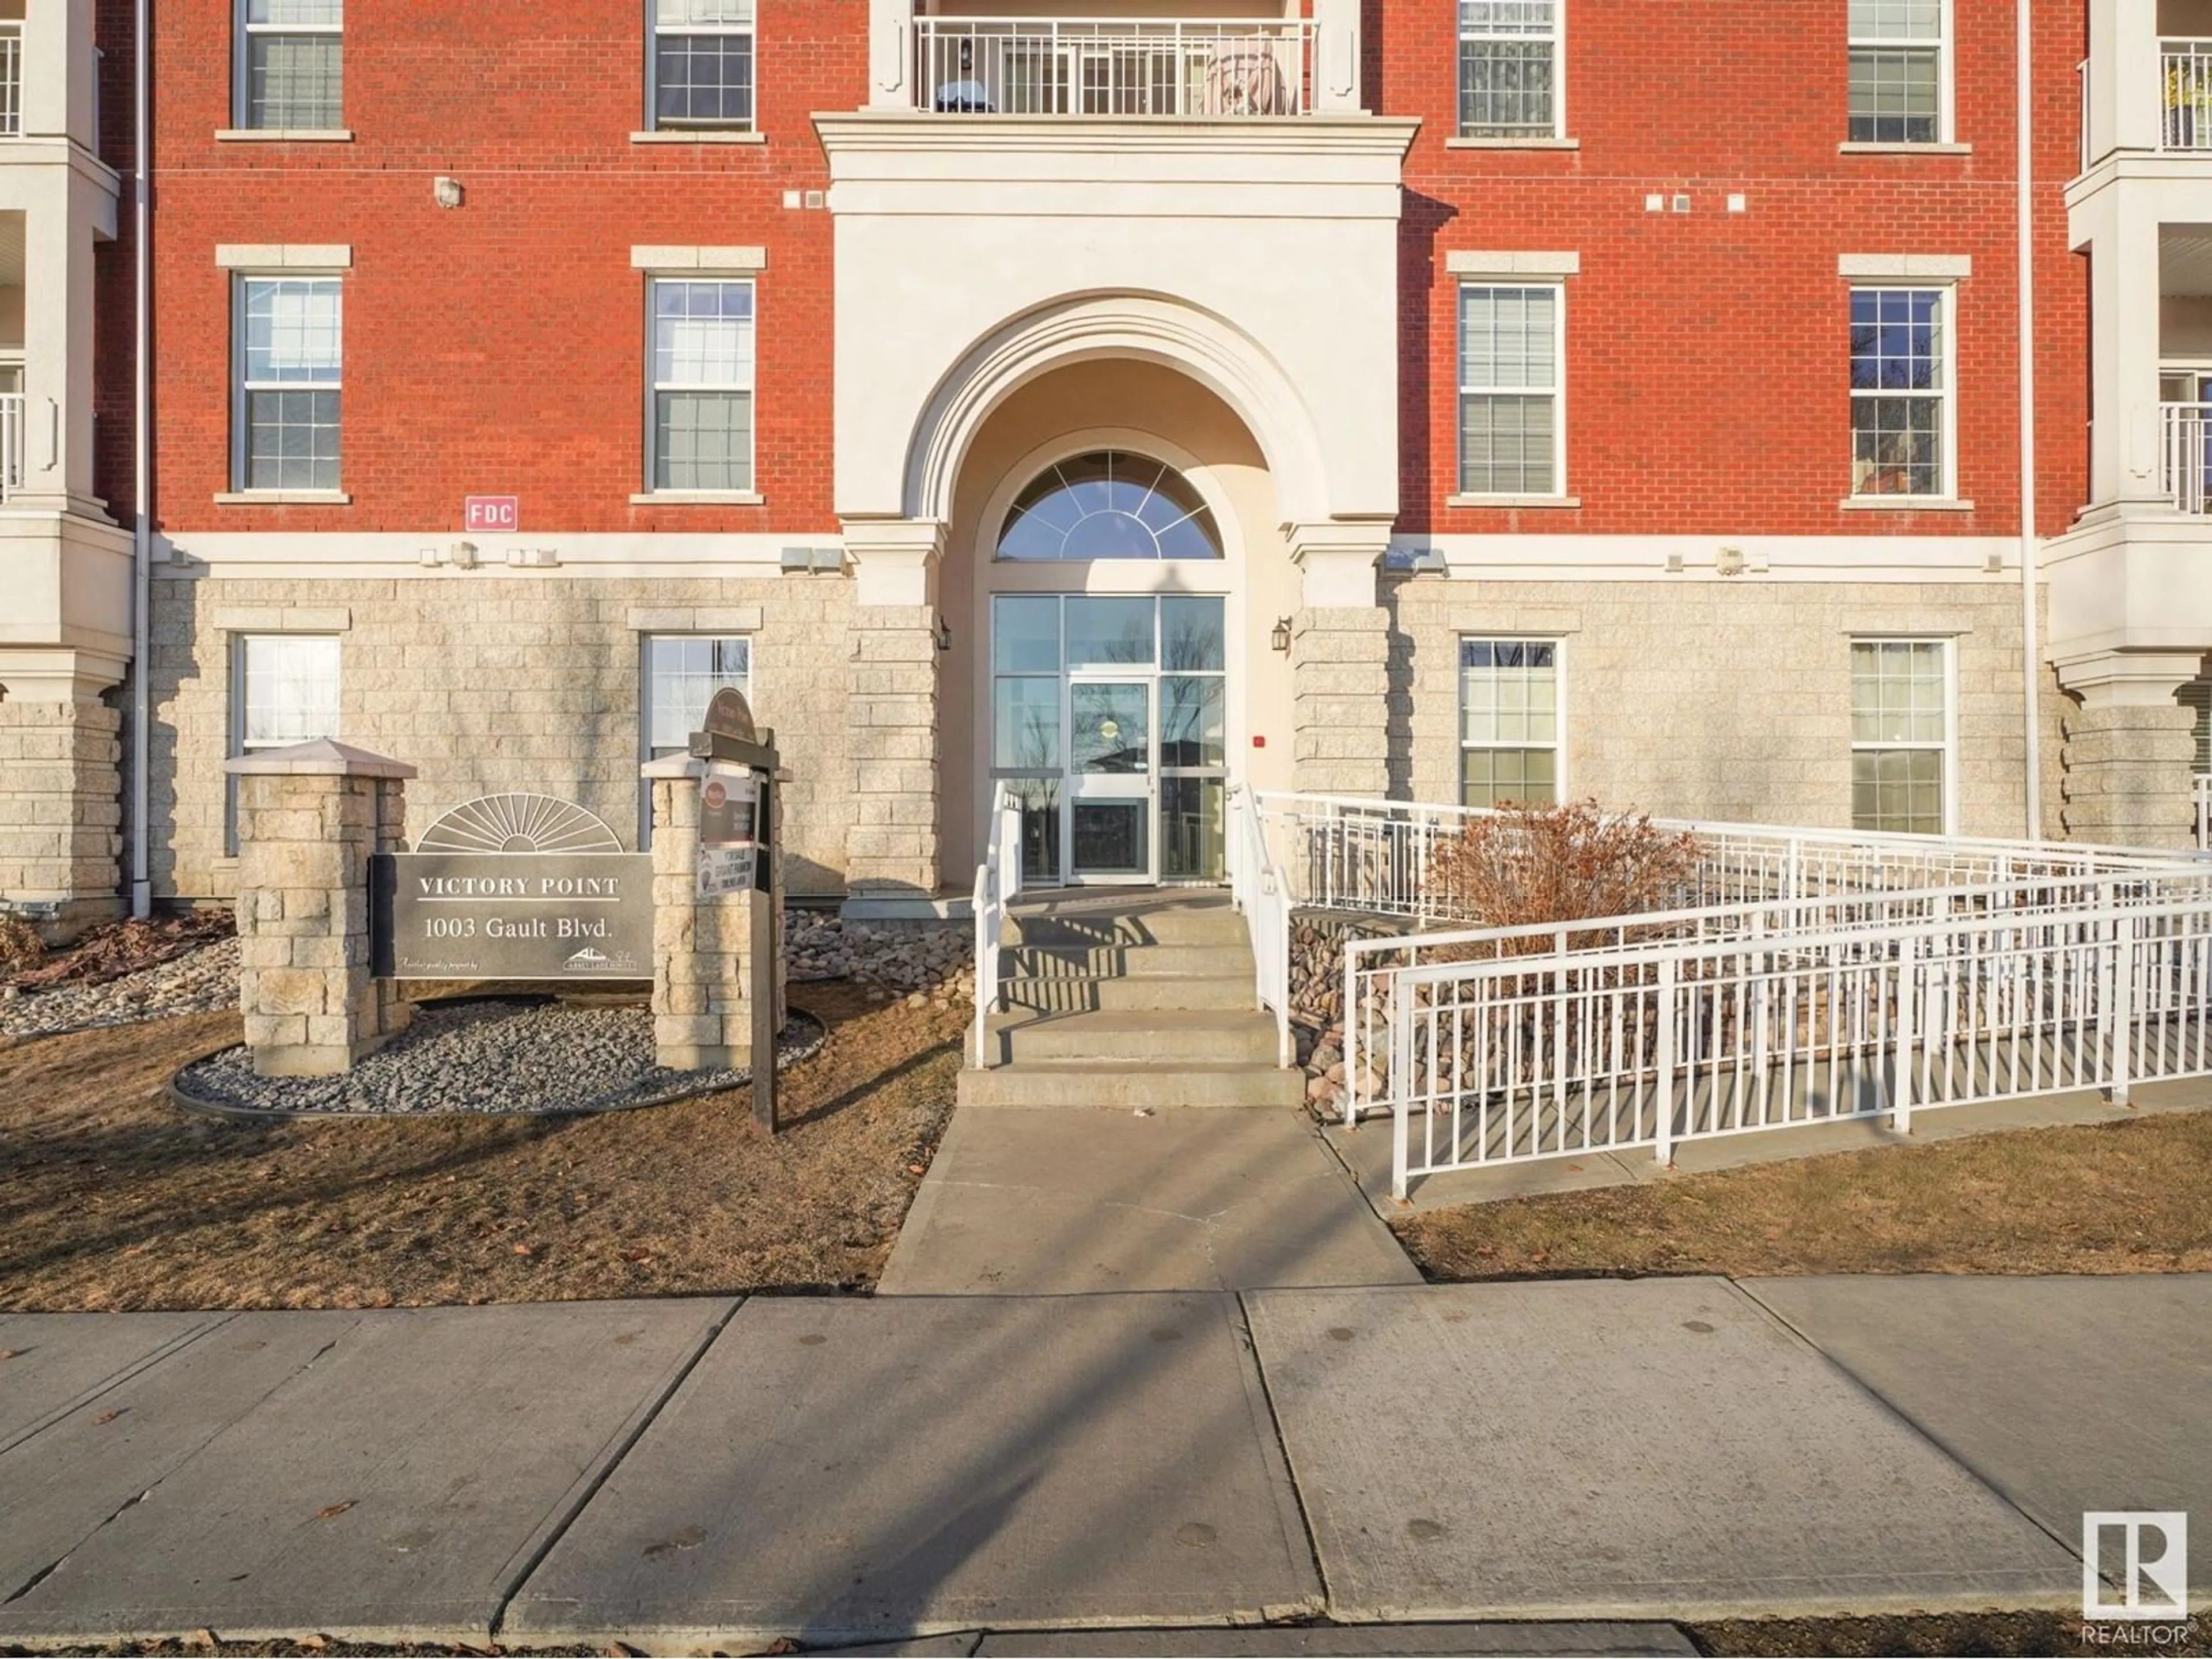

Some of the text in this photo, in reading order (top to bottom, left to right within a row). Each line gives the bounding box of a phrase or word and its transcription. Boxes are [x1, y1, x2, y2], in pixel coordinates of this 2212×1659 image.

[470, 504, 513, 523] FDC
[419, 877, 619, 895] VICTORY POINT
[425, 918, 612, 938] 1003 Gault Blvd.
